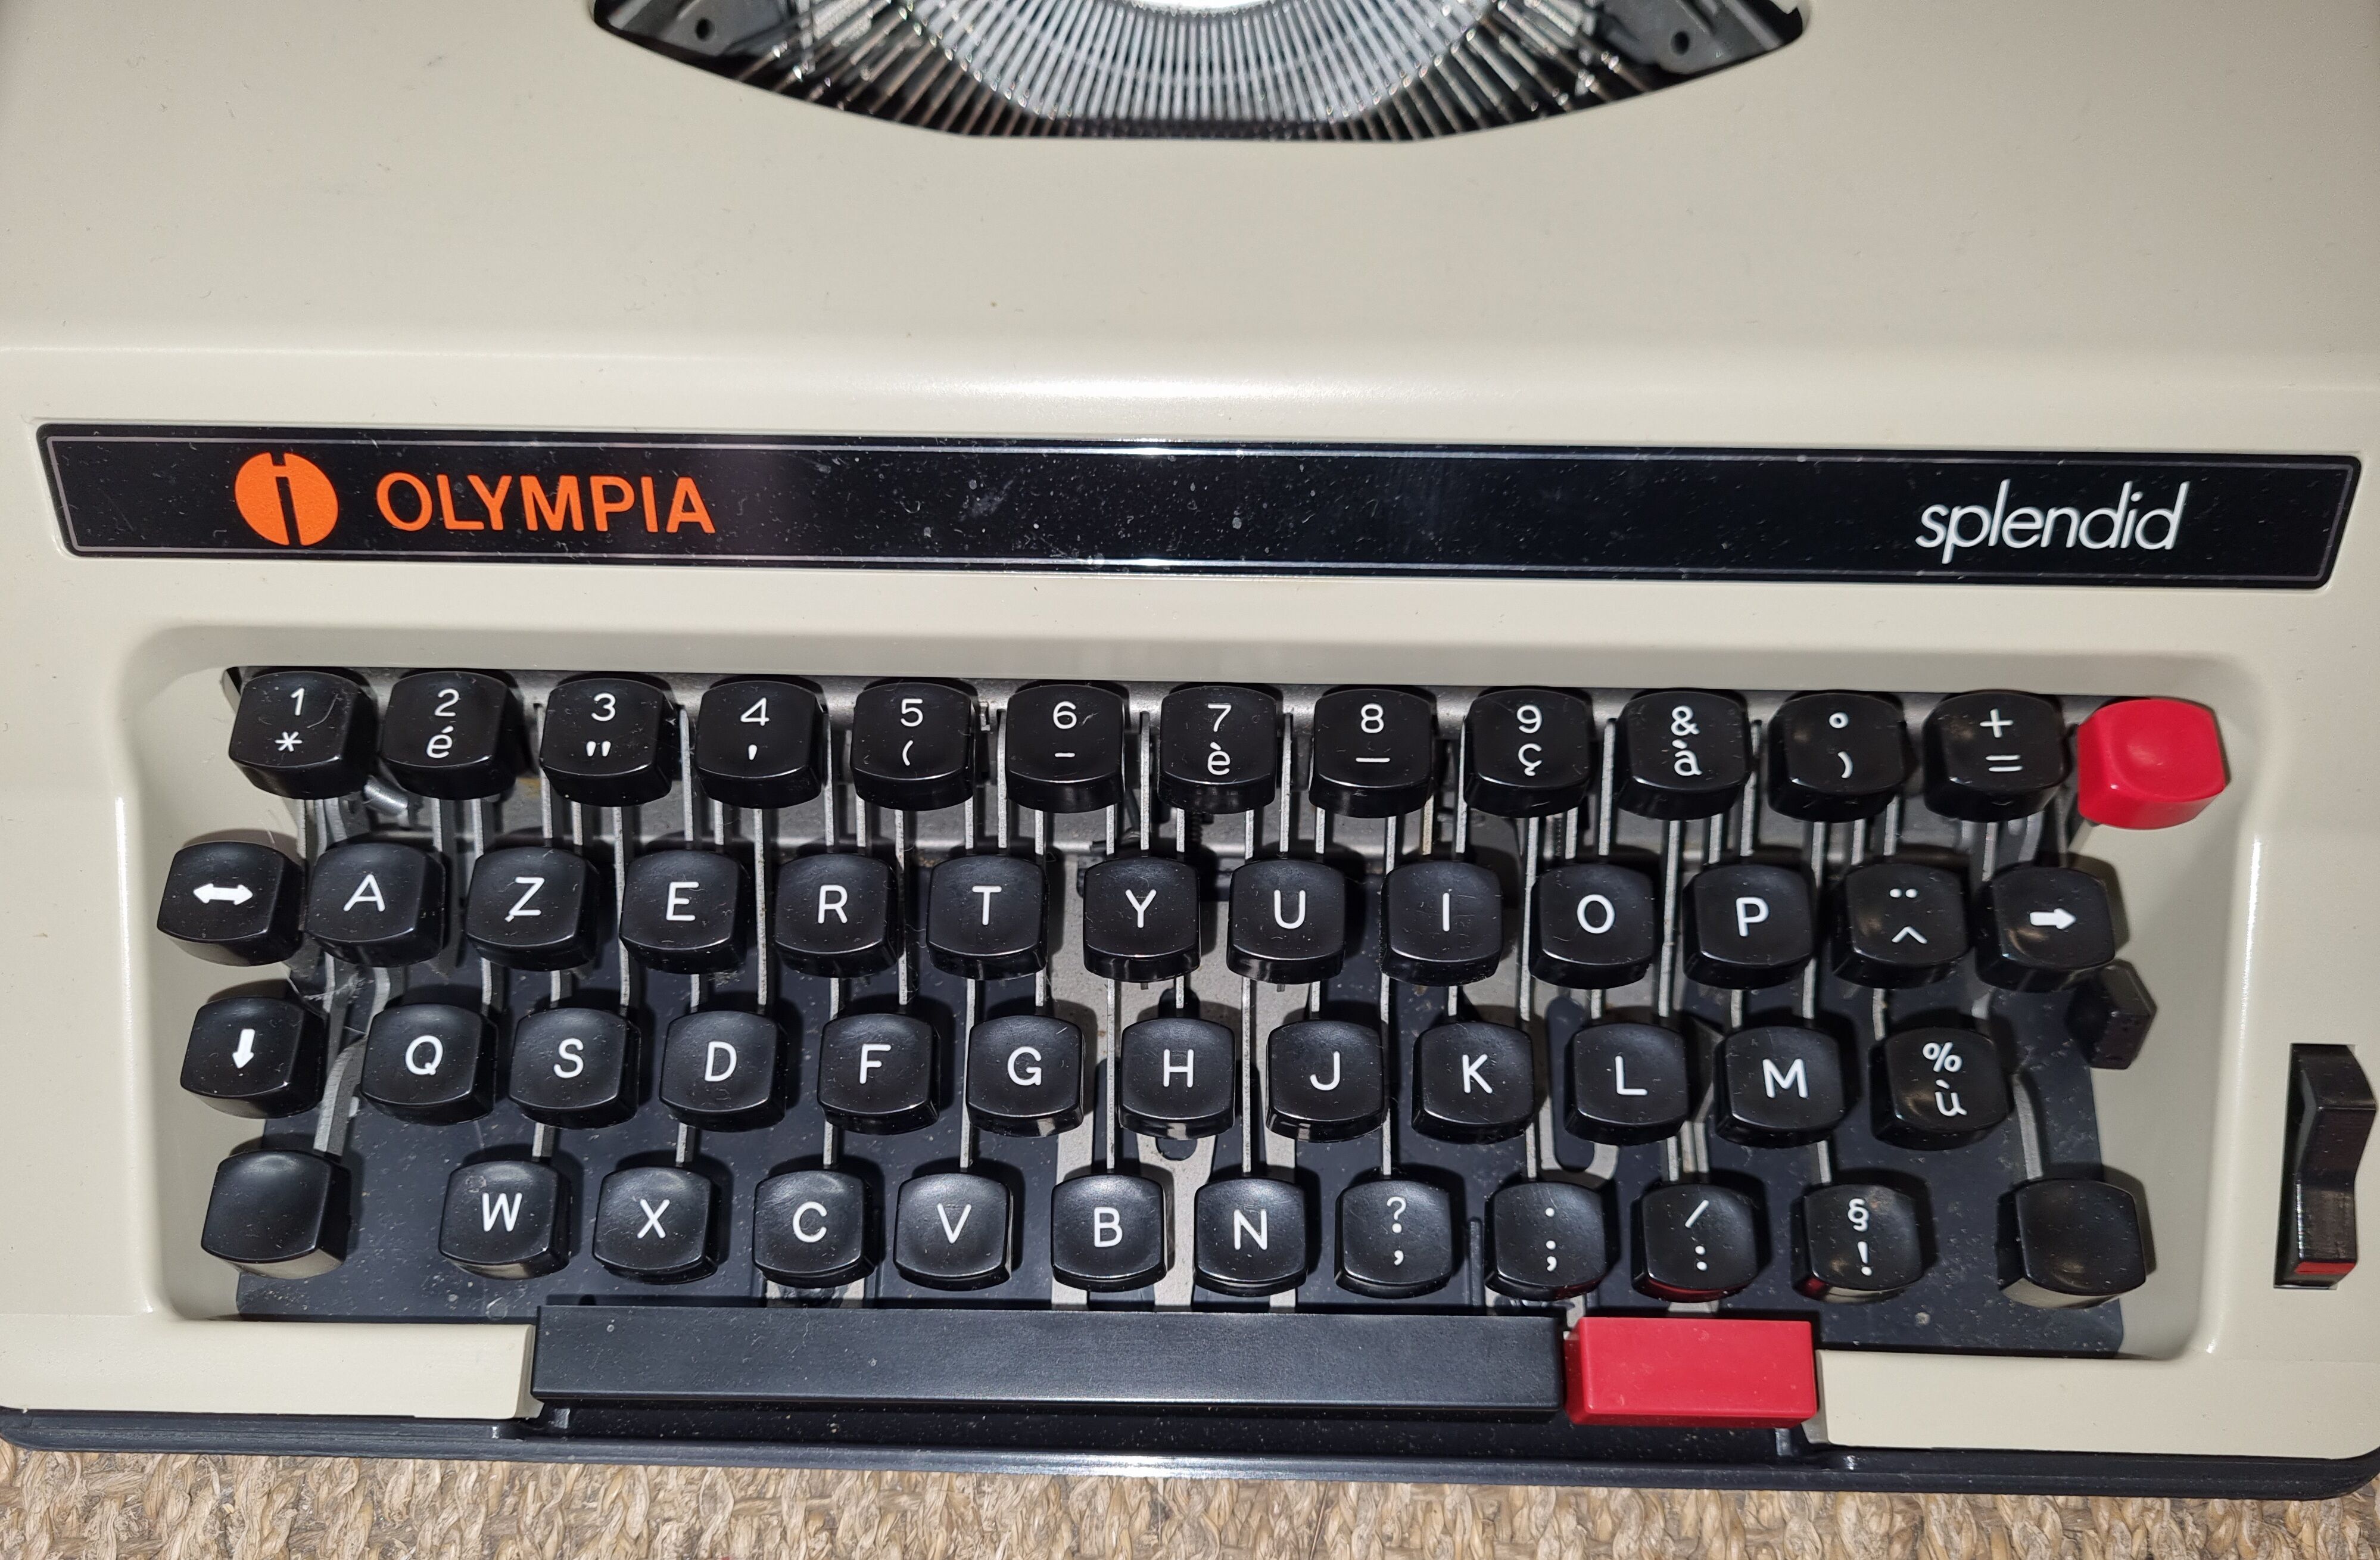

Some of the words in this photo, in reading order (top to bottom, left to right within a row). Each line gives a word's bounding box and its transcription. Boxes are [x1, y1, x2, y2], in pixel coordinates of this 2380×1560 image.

[376, 472, 716, 533] OLYMPIA
[1915, 479, 2191, 564] splendid
[291, 687, 305, 716] 1
[434, 689, 459, 717] 2
[591, 693, 616, 721] 3
[740, 698, 770, 726] 4
[901, 698, 923, 727] 5
[1053, 701, 1077, 729] 6
[1207, 703, 1232, 732] 7
[1360, 703, 1384, 733] 8
[1516, 705, 1542, 734] 9
[1671, 705, 1700, 736] &
[426, 725, 454, 758] é
[1980, 709, 2013, 738] +
[902, 740, 914, 766] (
[1207, 742, 1231, 776] è
[1518, 743, 1542, 776] ç
[1672, 740, 1702, 776] à
[1837, 752, 1852, 779] )
[343, 874, 385, 912] A
[506, 876, 545, 918] Z
[666, 881, 699, 921] E
[818, 885, 848, 924] R
[971, 885, 1002, 926] T
[1125, 889, 1157, 928] Y
[1273, 889, 1306, 929] U
[1443, 892, 1450, 932] I
[1577, 894, 1615, 934] O
[1736, 897, 1768, 937] P
[405, 1035, 443, 1075] Q
[553, 1038, 584, 1079] S
[705, 1041, 737, 1082] D
[859, 1043, 892, 1084] F
[1007, 1046, 1042, 1086] G
[1163, 1048, 1194, 1088] H
[1310, 1051, 1340, 1091] J
[1462, 1054, 1493, 1094] K
[1923, 1042, 1962, 1072] %
[1615, 1055, 1647, 1095] L
[1762, 1058, 1808, 1098] M
[1934, 1079, 1967, 1116] ù
[482, 1192, 522, 1232] W
[637, 1198, 670, 1238] X
[793, 1201, 827, 1243] C
[937, 1204, 971, 1244] V
[1094, 1206, 1123, 1247] B
[1233, 1209, 1268, 1250] N
[1387, 1196, 1407, 1234] ?
[1685, 1200, 1709, 1228] /
[1848, 1198, 1870, 1232] §
[1546, 1240, 1557, 1272] ;
[1695, 1245, 1707, 1271] :
[1857, 1241, 1872, 1276] !
